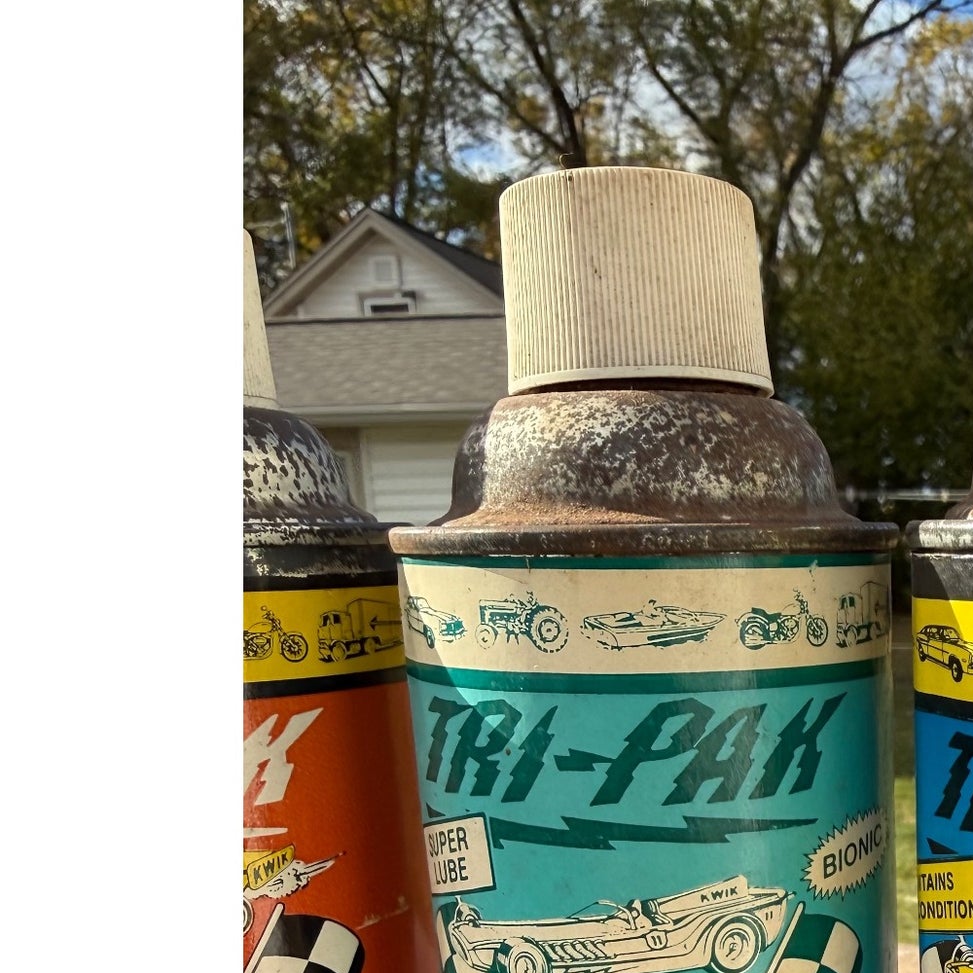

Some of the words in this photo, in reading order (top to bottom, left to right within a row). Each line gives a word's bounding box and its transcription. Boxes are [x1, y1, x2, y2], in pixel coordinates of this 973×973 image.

[426, 692, 848, 806] TRI-PAK
[428, 826, 469, 858] SUPER
[823, 823, 883, 879] BIONIC
[253, 853, 289, 884] KWIK
[434, 856, 469, 885] LUBE
[700, 886, 738, 903] KWIK
